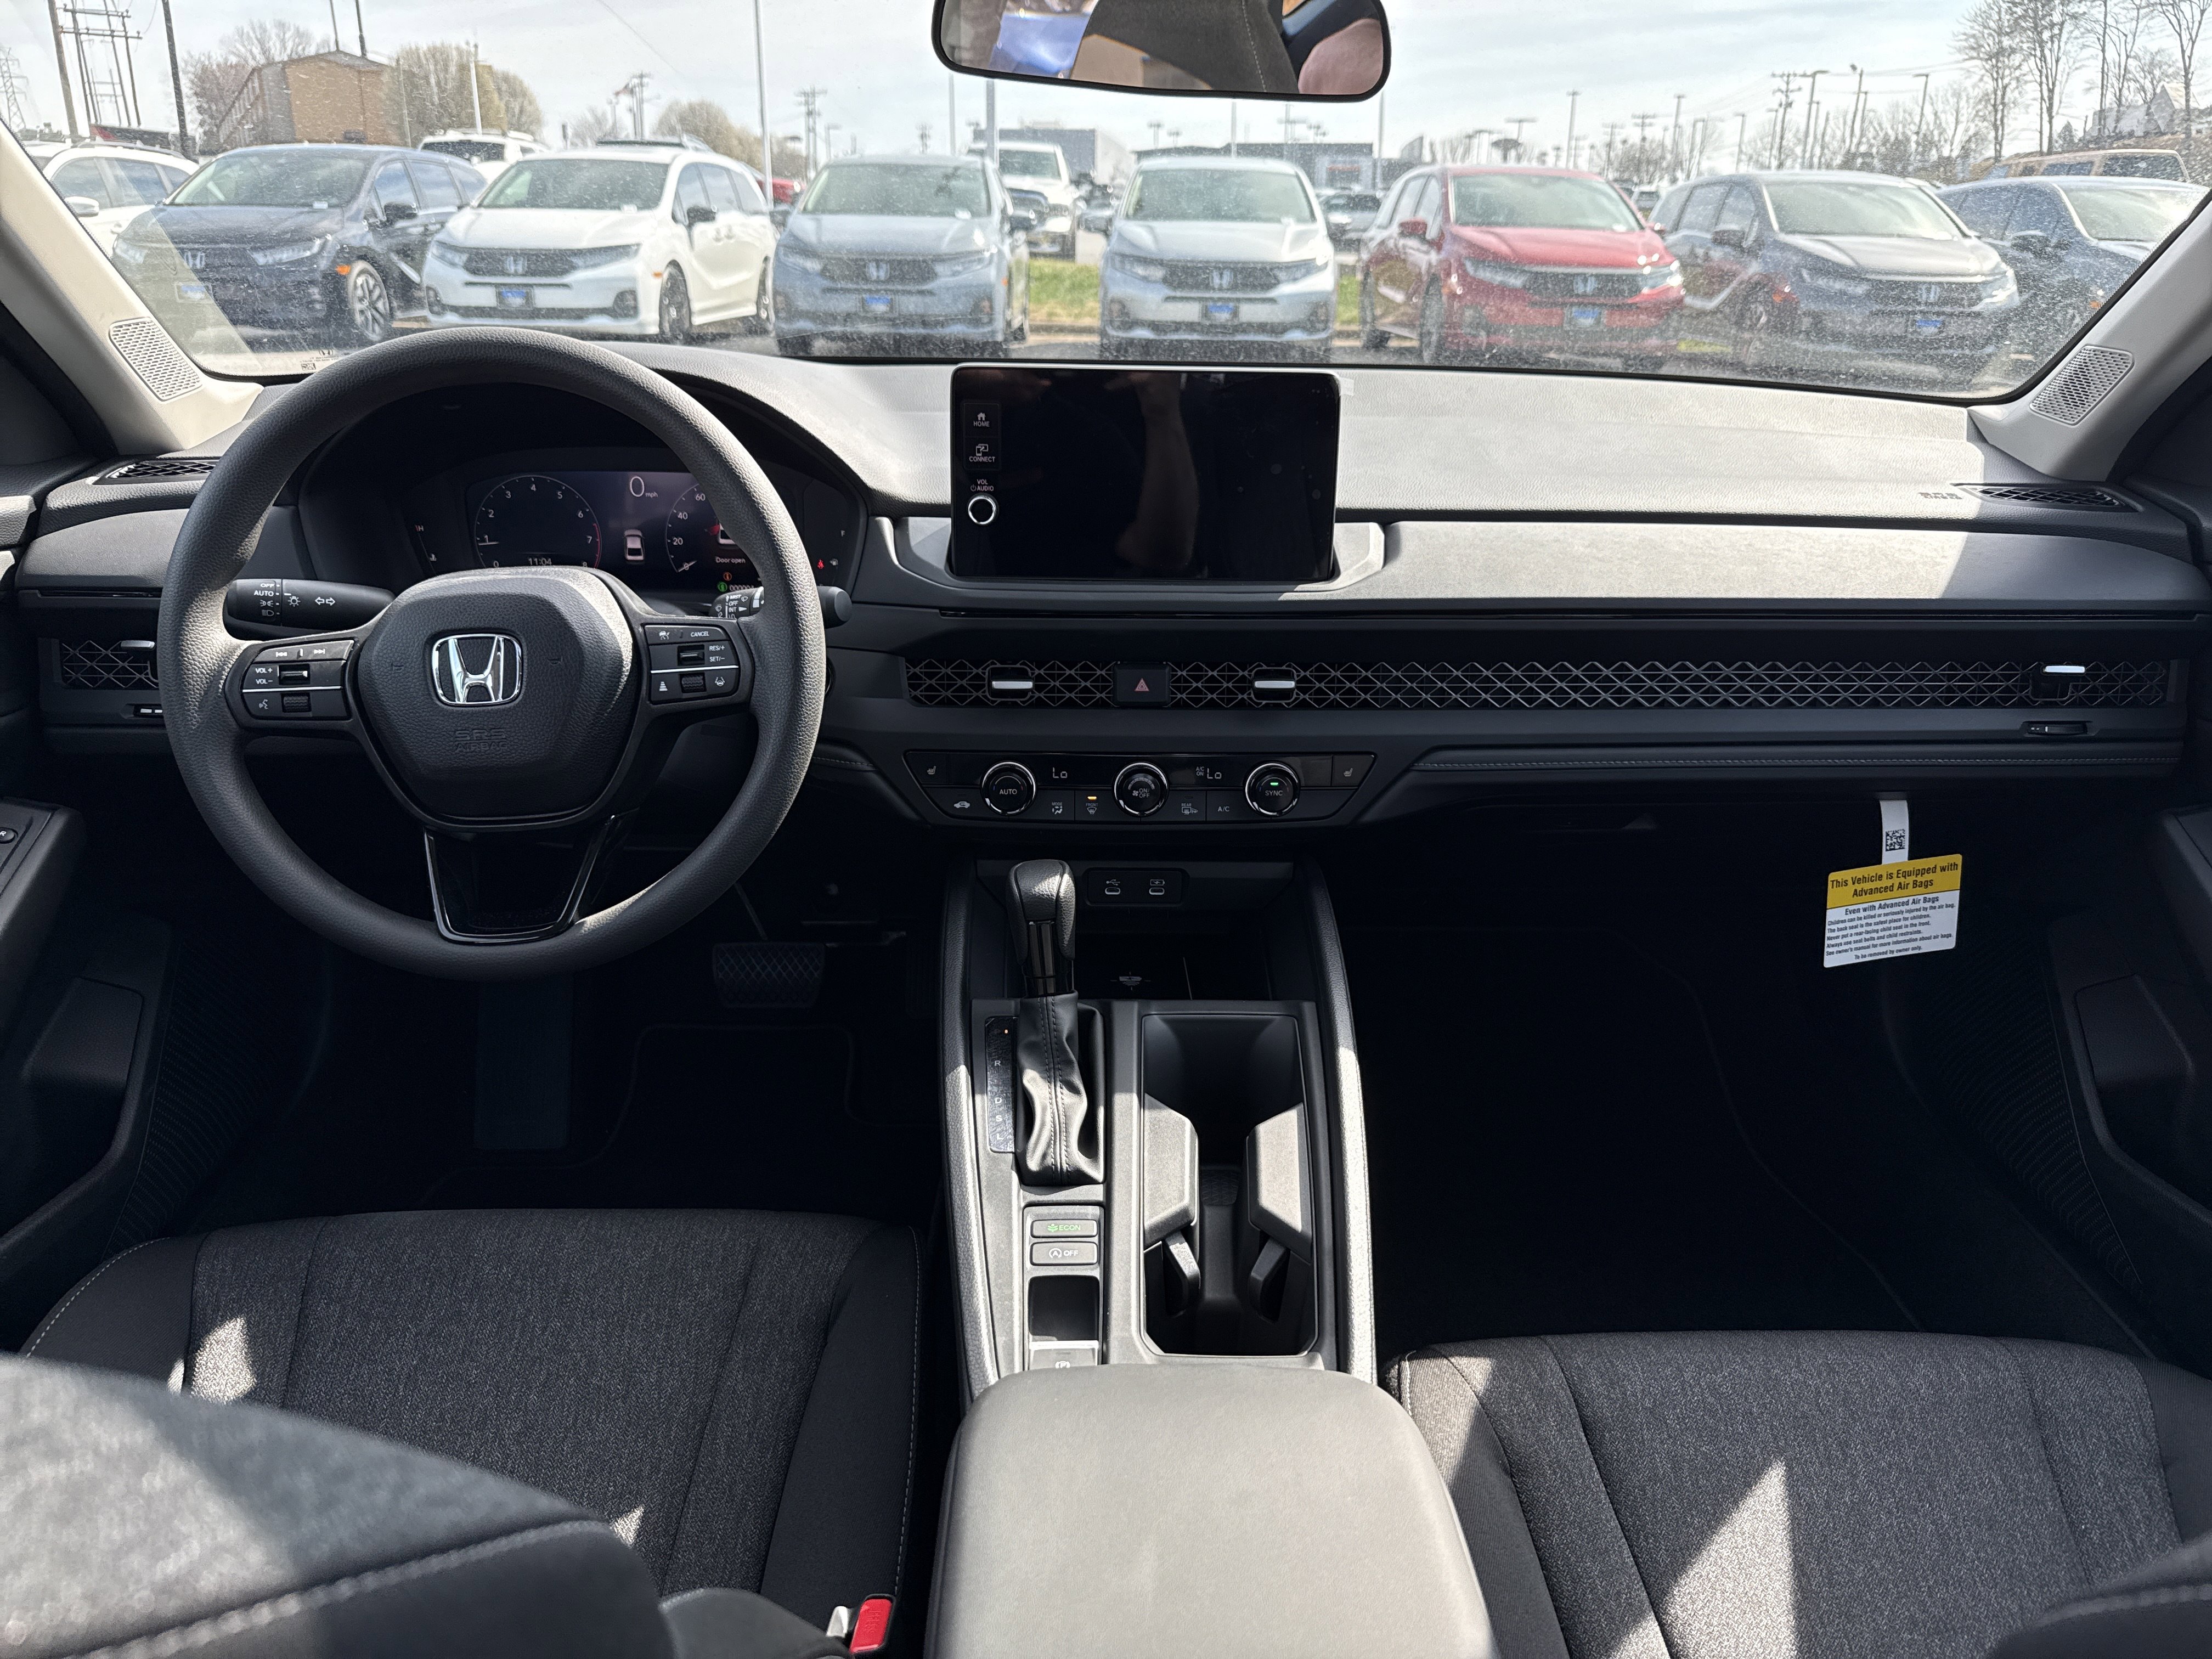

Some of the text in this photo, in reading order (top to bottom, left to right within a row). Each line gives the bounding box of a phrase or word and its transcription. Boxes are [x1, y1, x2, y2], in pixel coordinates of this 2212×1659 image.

[630, 476, 645, 497] 0
[488, 510, 494, 518] 2
[1830, 862, 1958, 889] This Vehicle is Equipped with
[1852, 879, 1933, 898] Advanced Air Bags
[1862, 904, 1876, 912] with
[1877, 900, 1909, 910] Advanced
